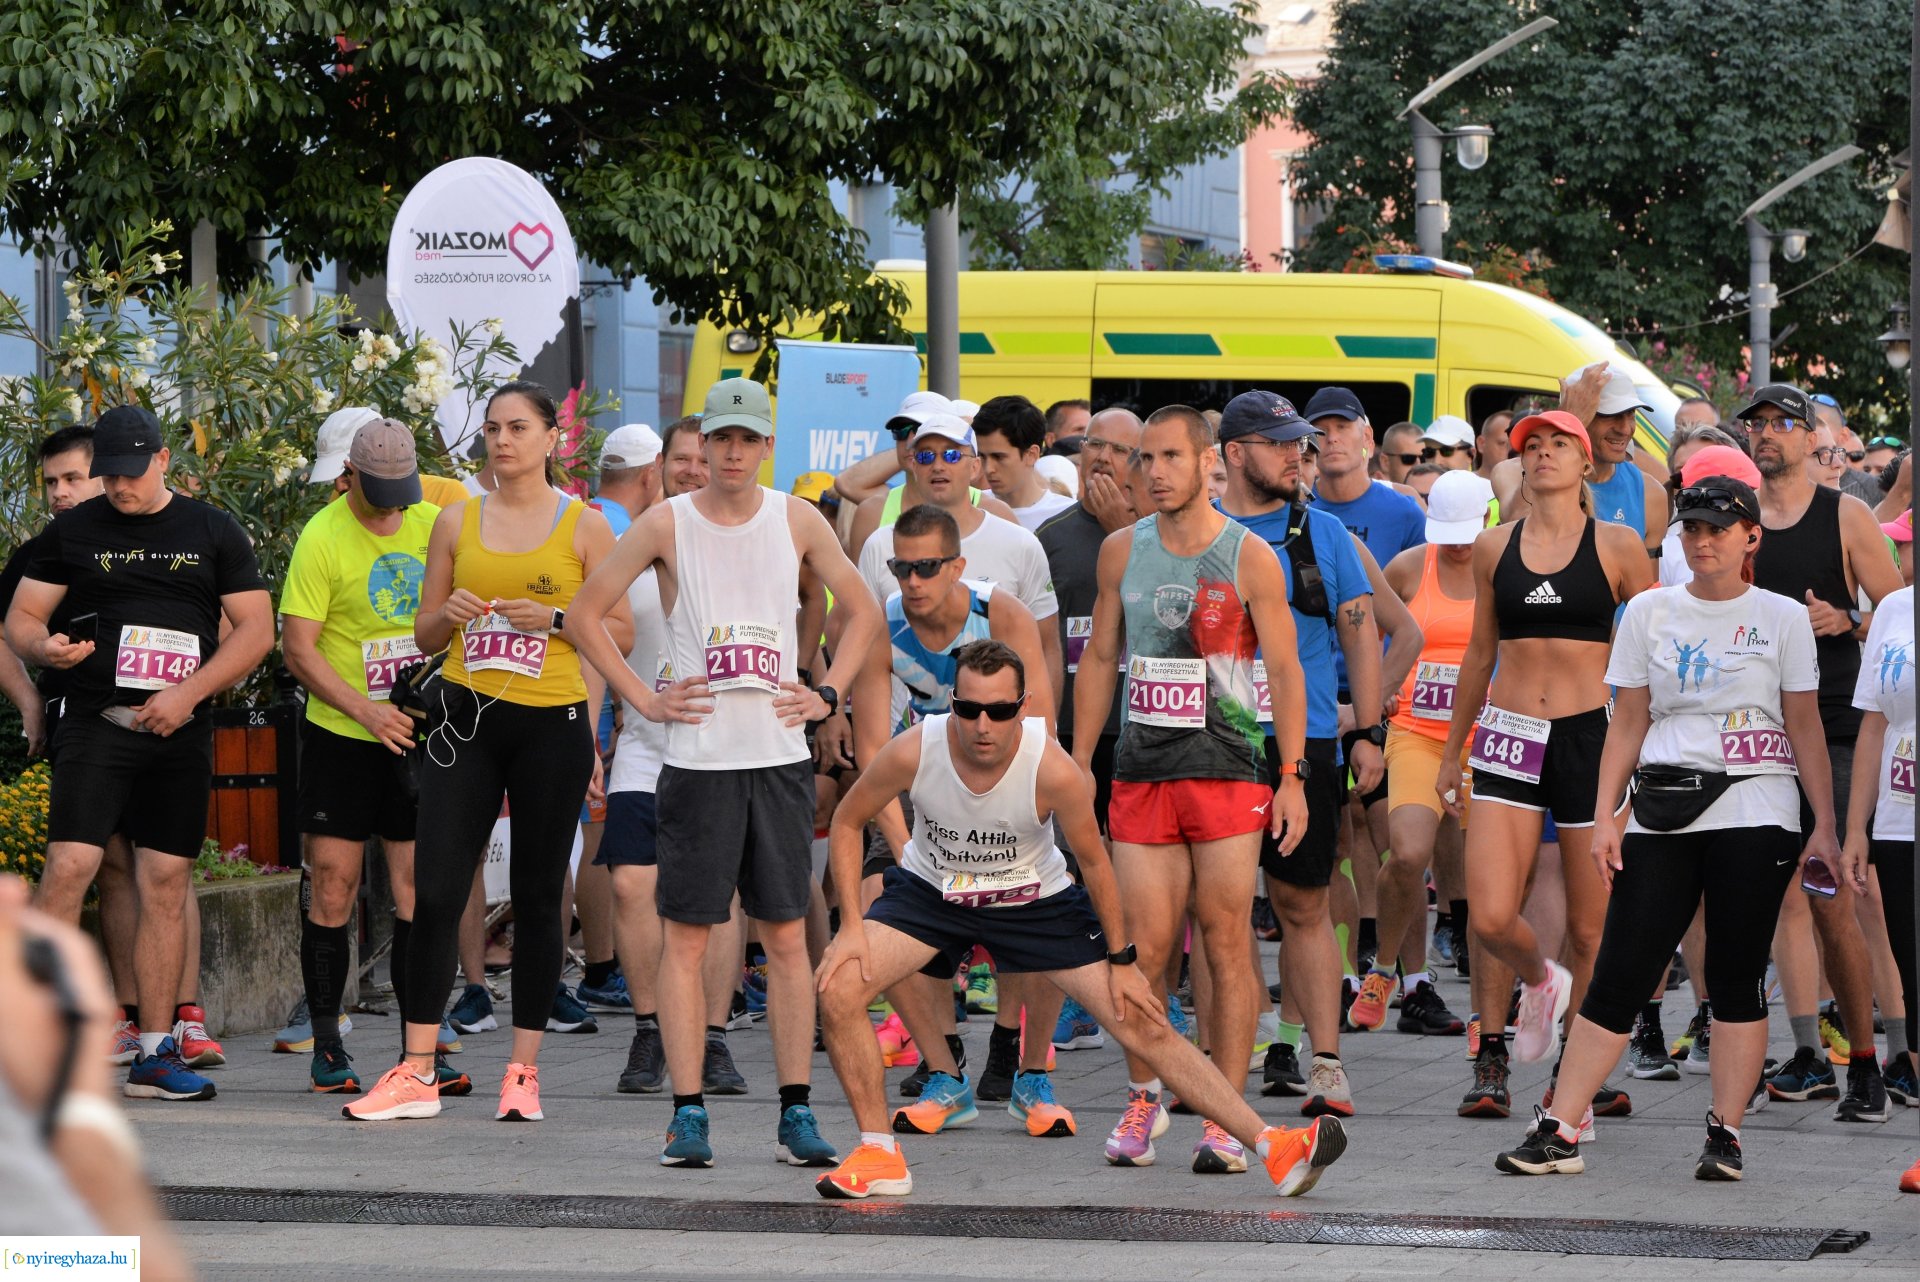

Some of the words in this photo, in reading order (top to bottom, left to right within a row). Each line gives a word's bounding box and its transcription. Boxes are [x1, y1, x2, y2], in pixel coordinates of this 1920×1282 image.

[825, 372, 867, 385] BLADESPORT
[732, 395, 743, 405] R
[809, 429, 878, 471] WHEY
[1160, 590, 1189, 601] MFSE
[1207, 590, 1226, 602] 575
[1524, 594, 1562, 604] adidas
[465, 635, 543, 664] 21162
[1751, 638, 1769, 647] TKM
[120, 650, 196, 680] 21148
[708, 648, 778, 677] 21160
[1130, 682, 1203, 710] 21004
[1483, 733, 1526, 765] 648
[1724, 733, 1792, 759] 21220
[923, 814, 960, 842] Kiss
[966, 829, 1018, 845] Attila
